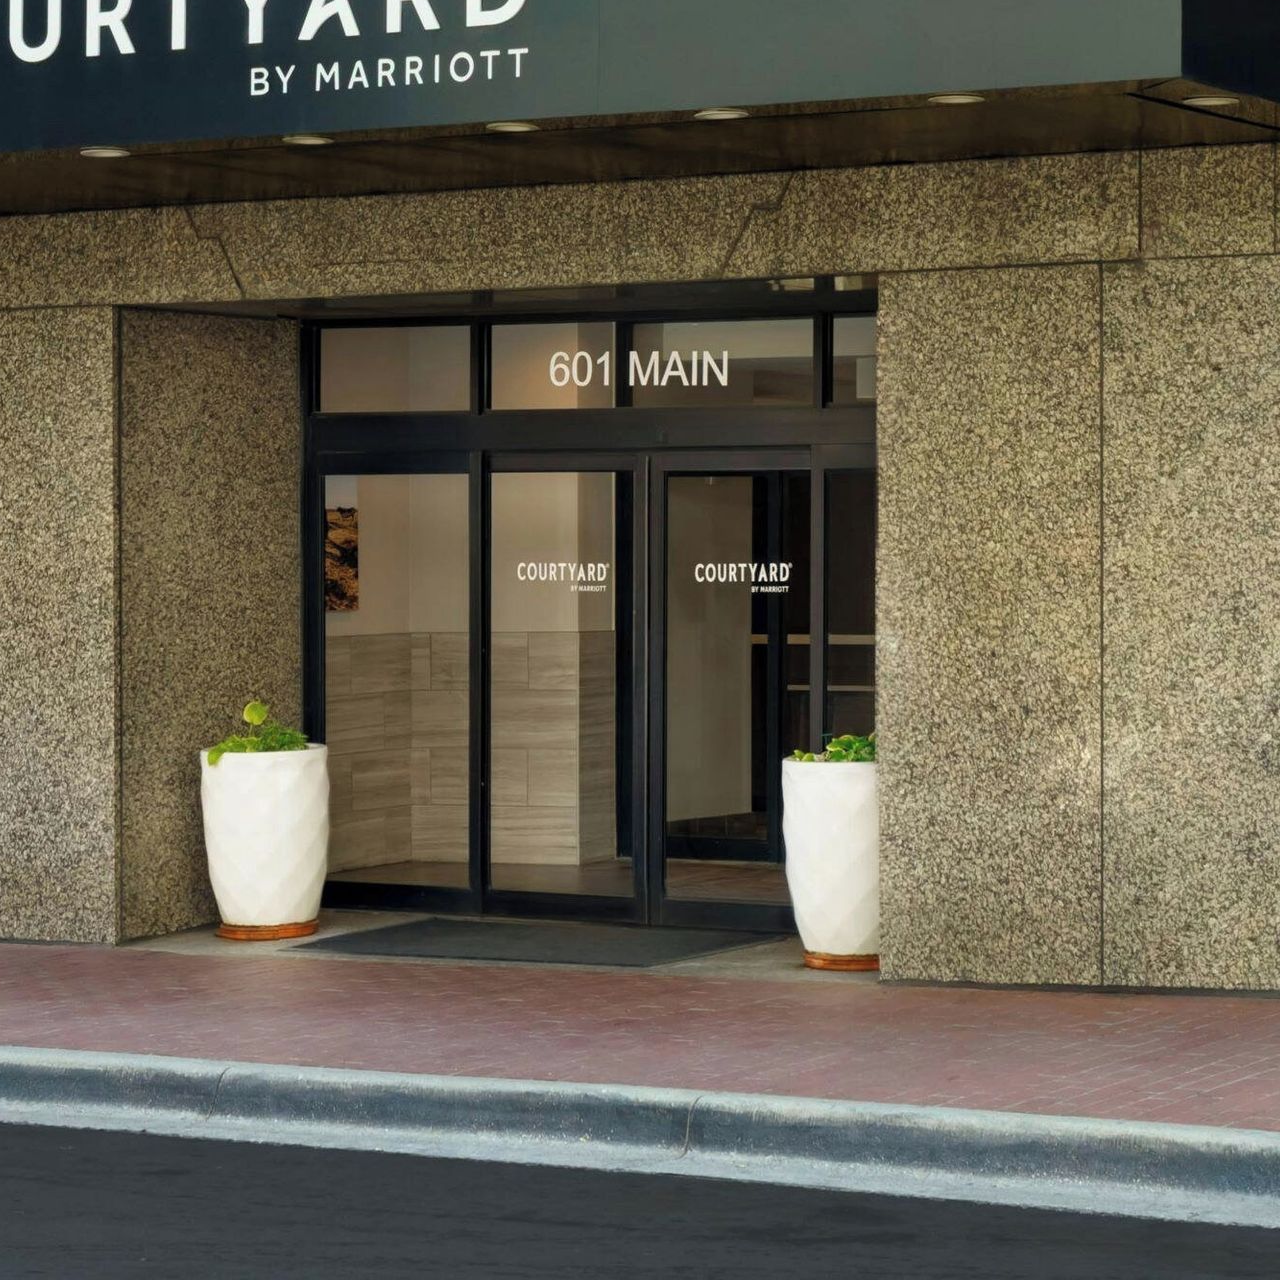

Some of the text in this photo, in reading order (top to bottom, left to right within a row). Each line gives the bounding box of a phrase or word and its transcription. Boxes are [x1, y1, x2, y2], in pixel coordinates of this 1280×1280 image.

[250, 47, 530, 96] BY MARRIOTT
[549, 350, 729, 387] 601 MAIN
